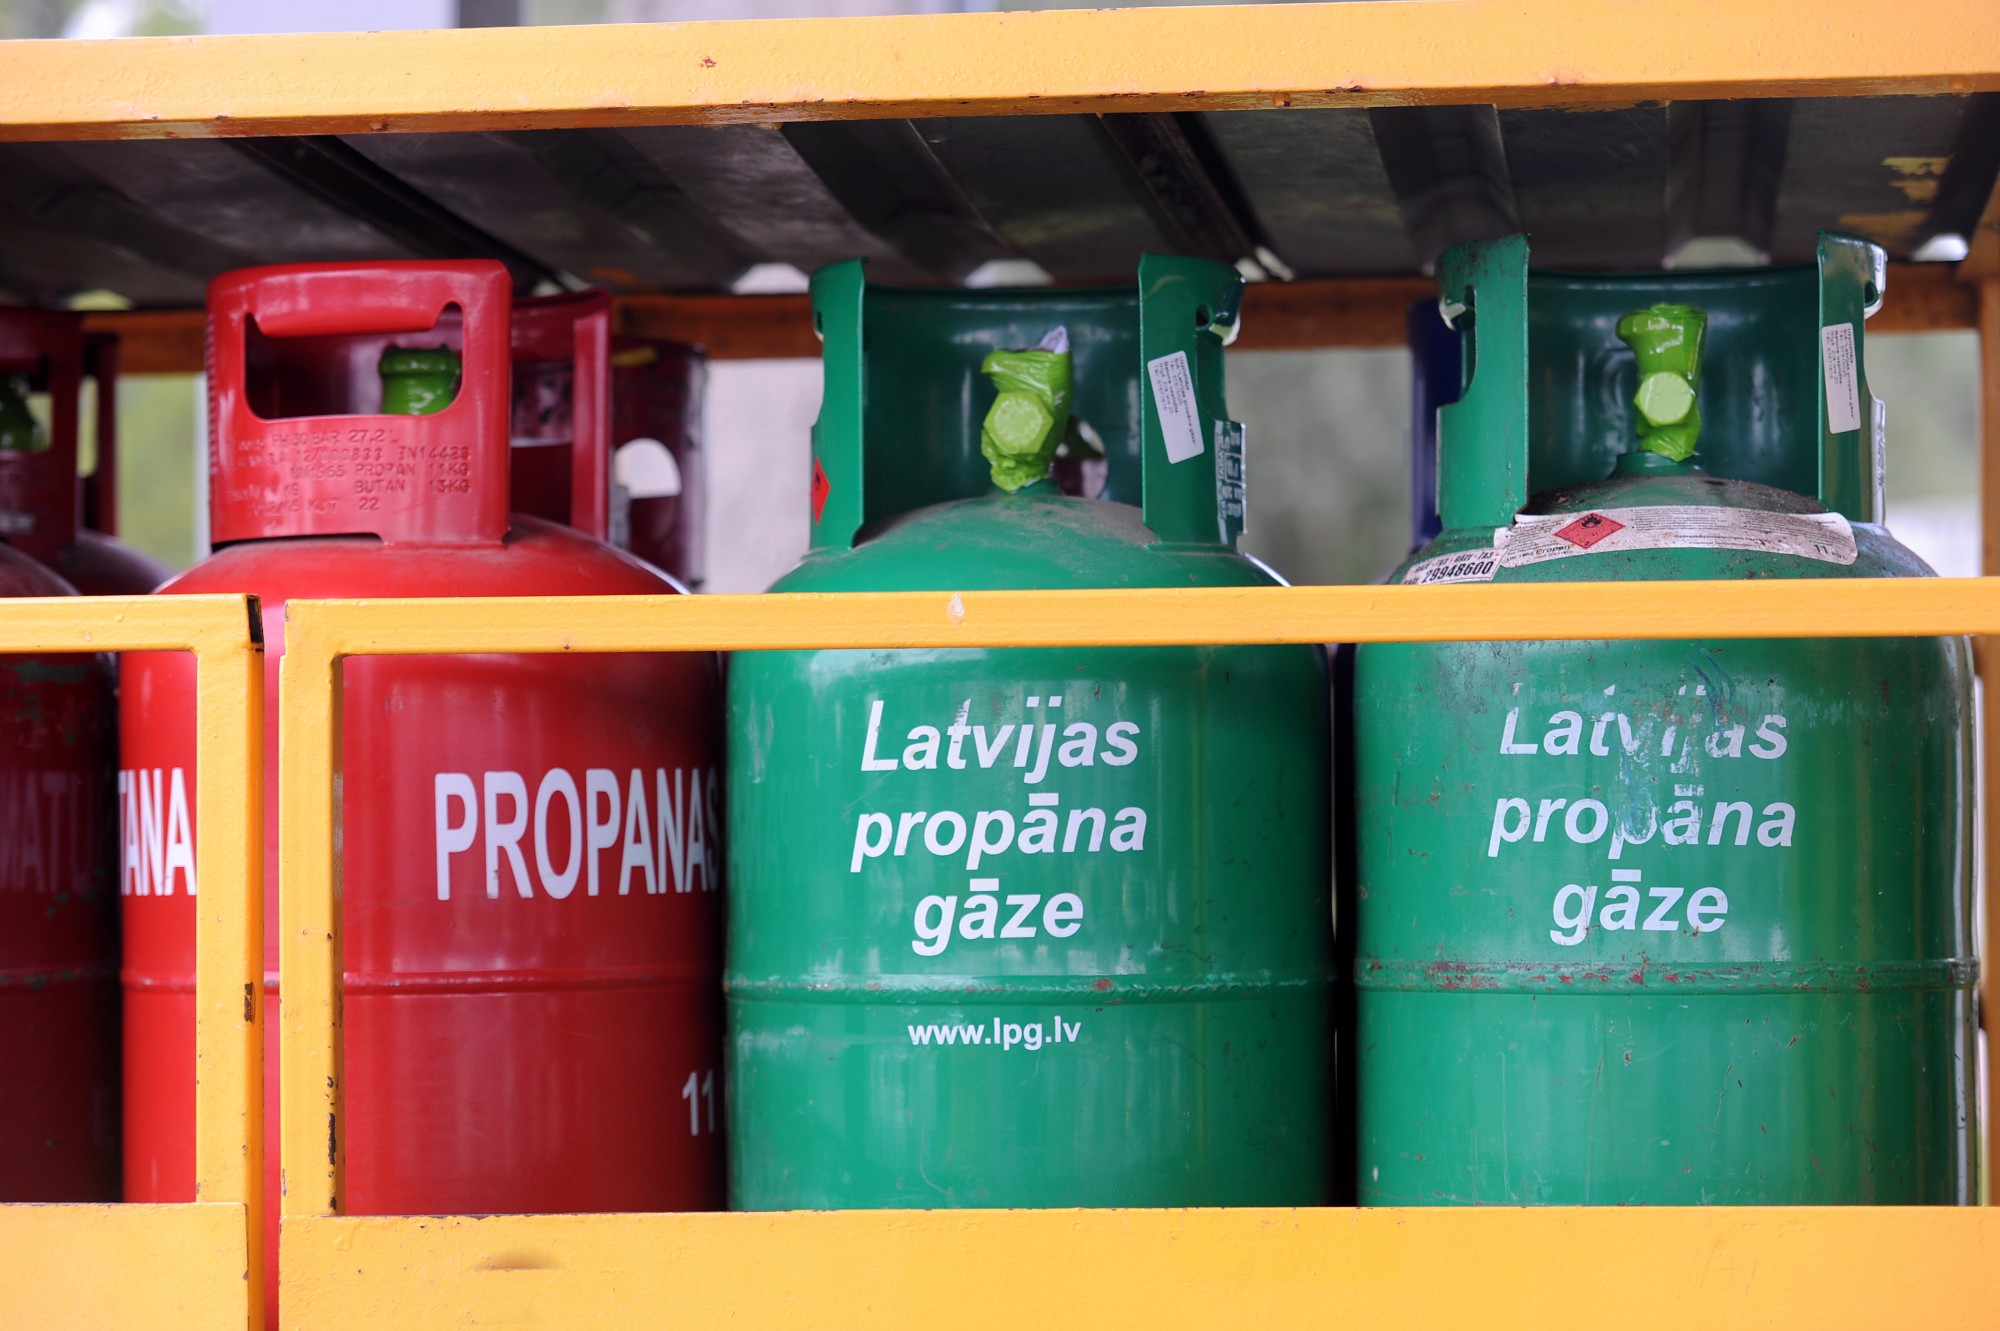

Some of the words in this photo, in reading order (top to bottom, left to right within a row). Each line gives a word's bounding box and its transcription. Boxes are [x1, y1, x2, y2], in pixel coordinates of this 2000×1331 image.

[354, 479, 406, 494] BUTAN
[355, 462, 416, 477] PROPAN
[360, 497, 380, 511] 22
[1421, 561, 1495, 584] 29948600
[861, 696, 1141, 784] Latvijas
[850, 792, 1148, 873] propāna
[1487, 784, 1797, 860] propāna
[911, 877, 1085, 957] gāze
[1549, 868, 1729, 947] gāze
[907, 1015, 1082, 1052] www.lpg.lv
[682, 1069, 716, 1137] 11
